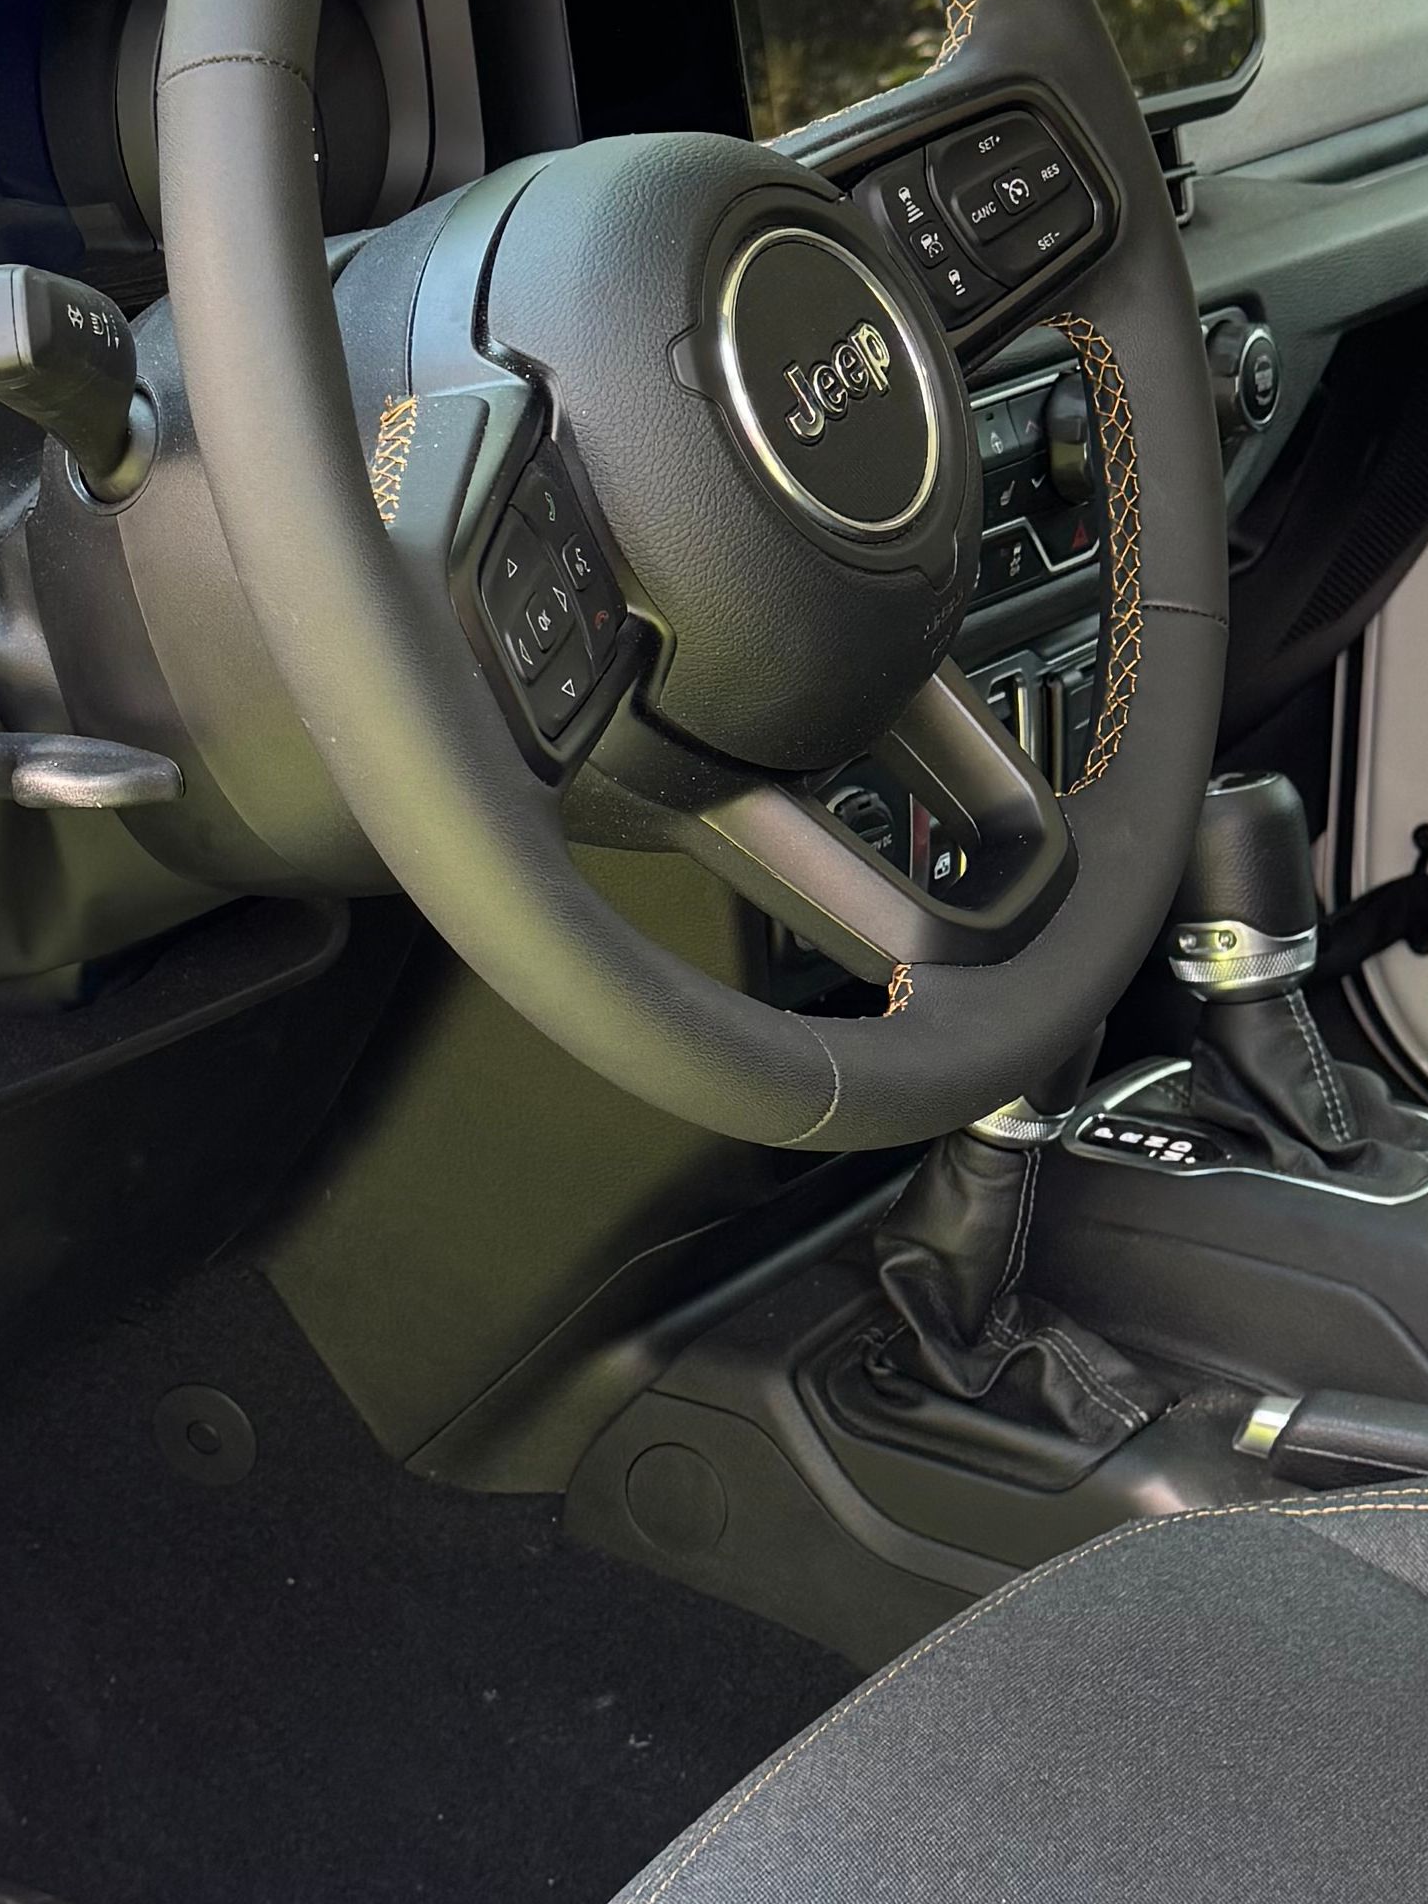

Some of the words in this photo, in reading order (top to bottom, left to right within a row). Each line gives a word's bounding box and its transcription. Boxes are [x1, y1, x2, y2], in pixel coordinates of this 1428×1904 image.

[1040, 163, 1060, 181] RES
[971, 201, 997, 224] CANC
[783, 322, 891, 439] Jeep
